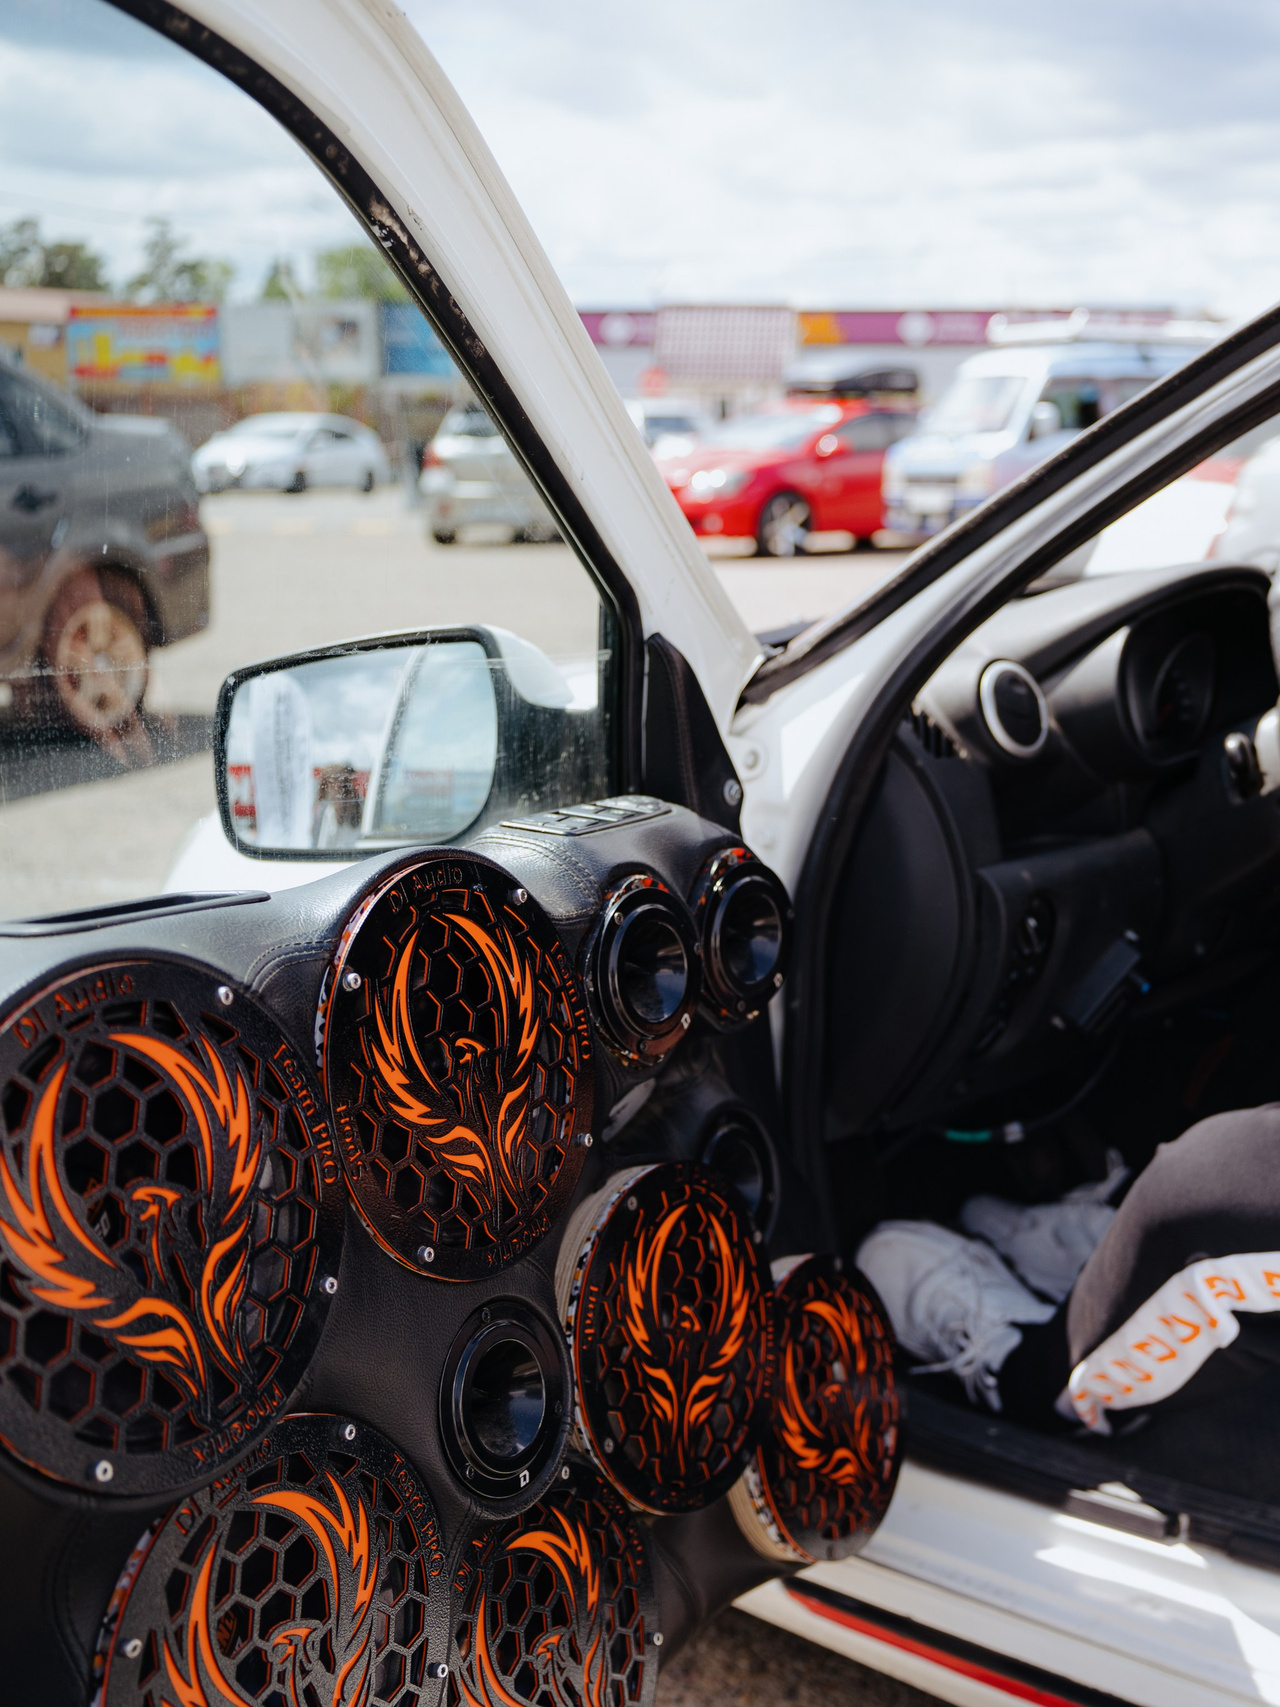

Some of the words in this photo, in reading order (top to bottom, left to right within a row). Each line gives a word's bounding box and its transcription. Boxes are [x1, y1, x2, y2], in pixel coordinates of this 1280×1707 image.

[412, 862, 464, 898] Audio
[53, 971, 134, 1023] Audio
[574, 1008, 594, 1060] PRO
[272, 1035, 318, 1118] Team
[311, 1121, 340, 1185] PRO
[389, 1450, 428, 1520] Team
[420, 1517, 446, 1578] PRO
